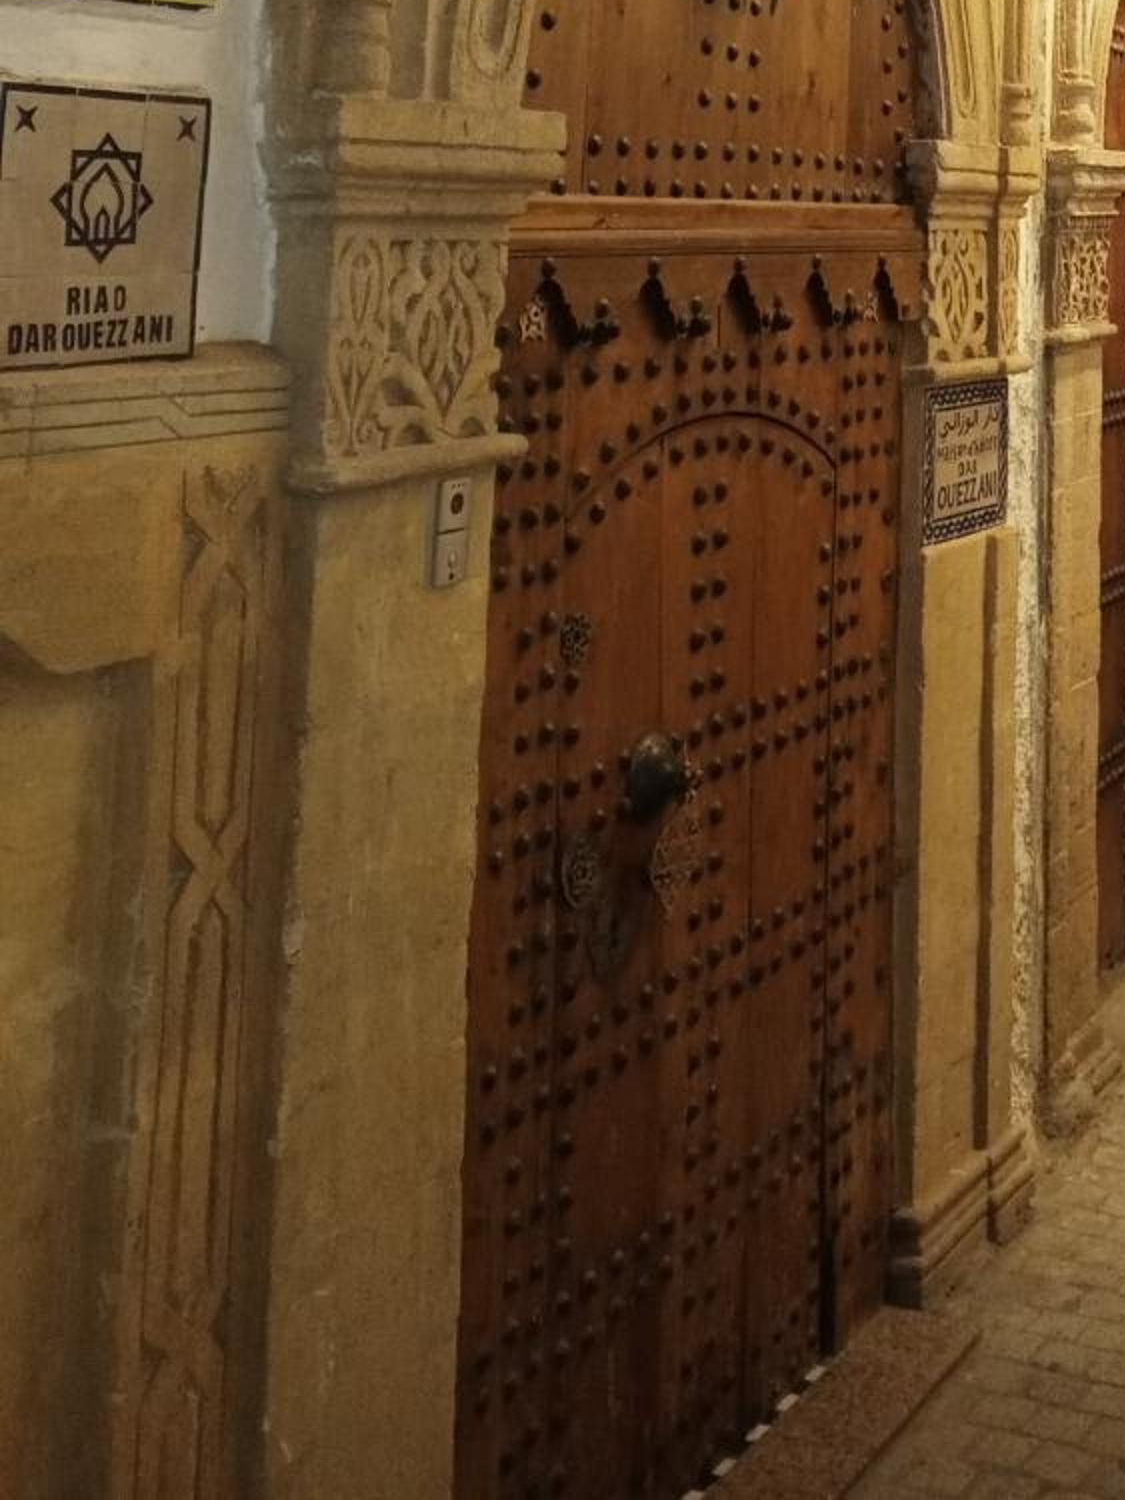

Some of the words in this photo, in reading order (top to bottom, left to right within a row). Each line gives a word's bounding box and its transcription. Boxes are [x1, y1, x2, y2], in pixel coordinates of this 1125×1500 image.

[7, 323, 58, 356] DAR
[62, 315, 174, 351] OUEZZANI
[937, 470, 998, 510] OUEZZANI
